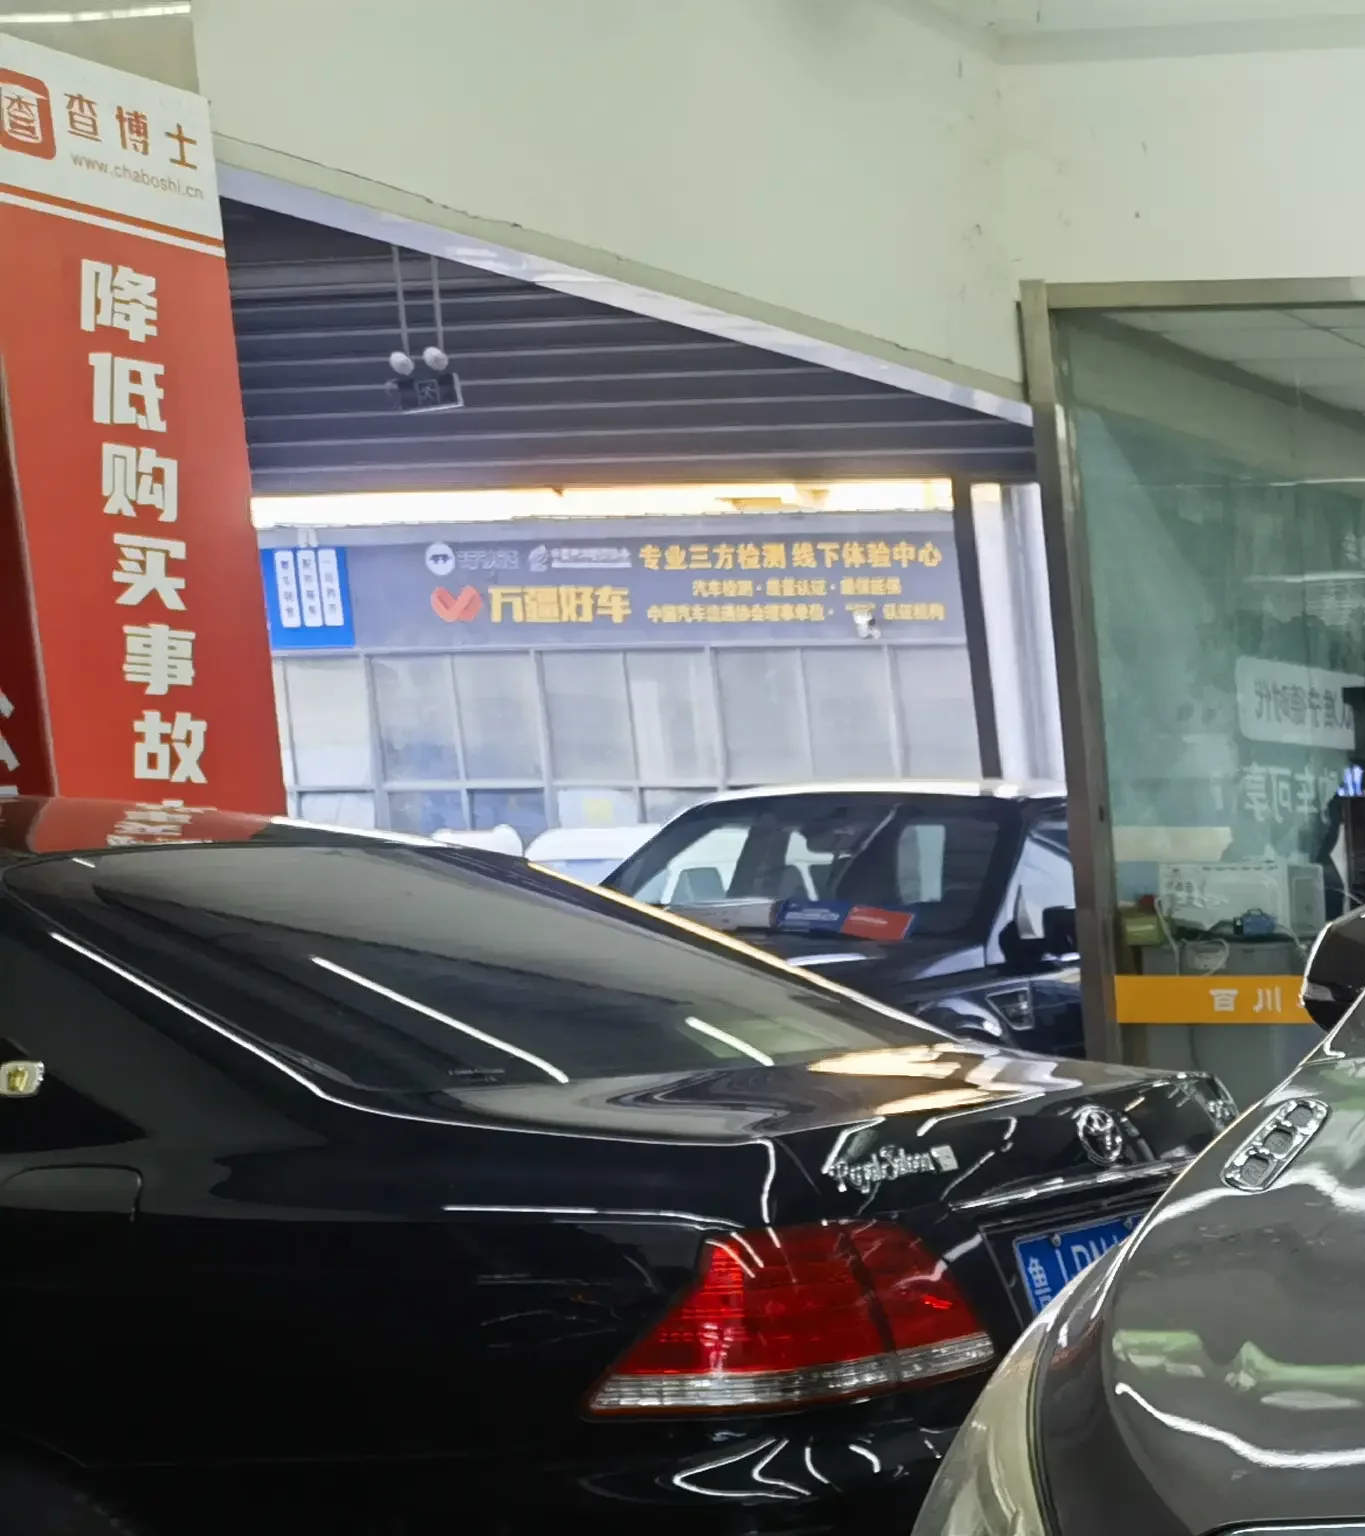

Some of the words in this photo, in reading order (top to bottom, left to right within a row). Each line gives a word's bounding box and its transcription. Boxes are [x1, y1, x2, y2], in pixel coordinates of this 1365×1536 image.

[63, 93, 199, 171] 查博士
[69, 152, 205, 199] www.chaboshi.cn
[80, 257, 217, 812] 降低购买事故
[1209, 985, 1304, 1013] 百川
